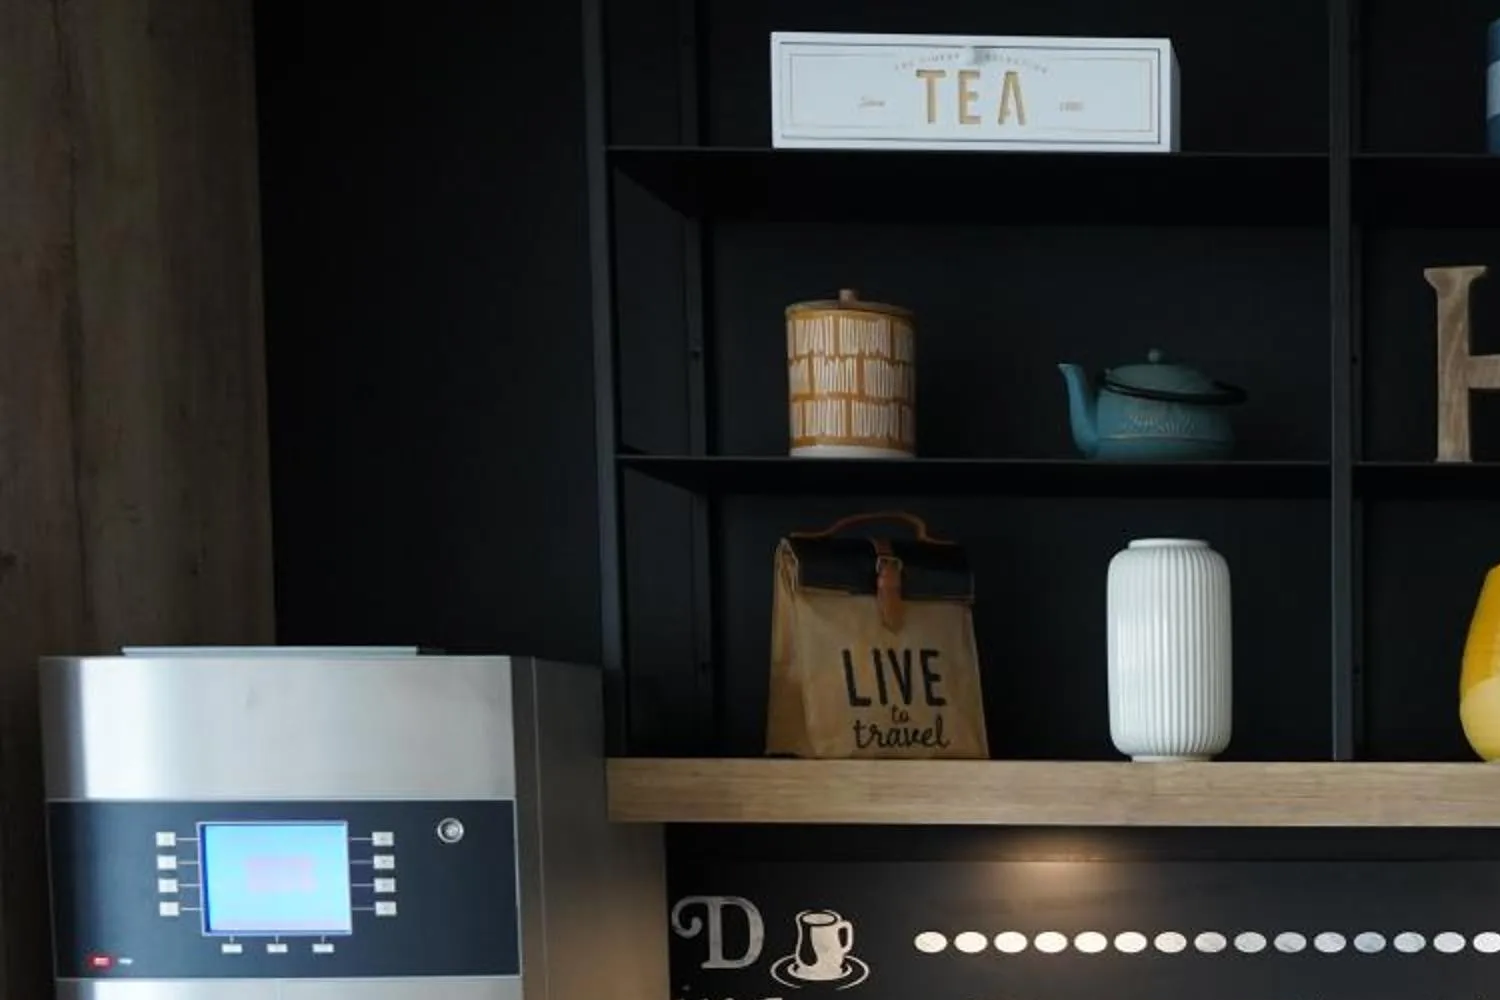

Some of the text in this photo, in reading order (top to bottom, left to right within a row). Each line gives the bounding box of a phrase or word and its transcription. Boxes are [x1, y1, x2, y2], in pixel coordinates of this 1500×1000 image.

[915, 68, 1026, 125] TEA
[841, 647, 949, 708] LIVE
[853, 715, 951, 750] travel
[891, 702, 910, 723] to
